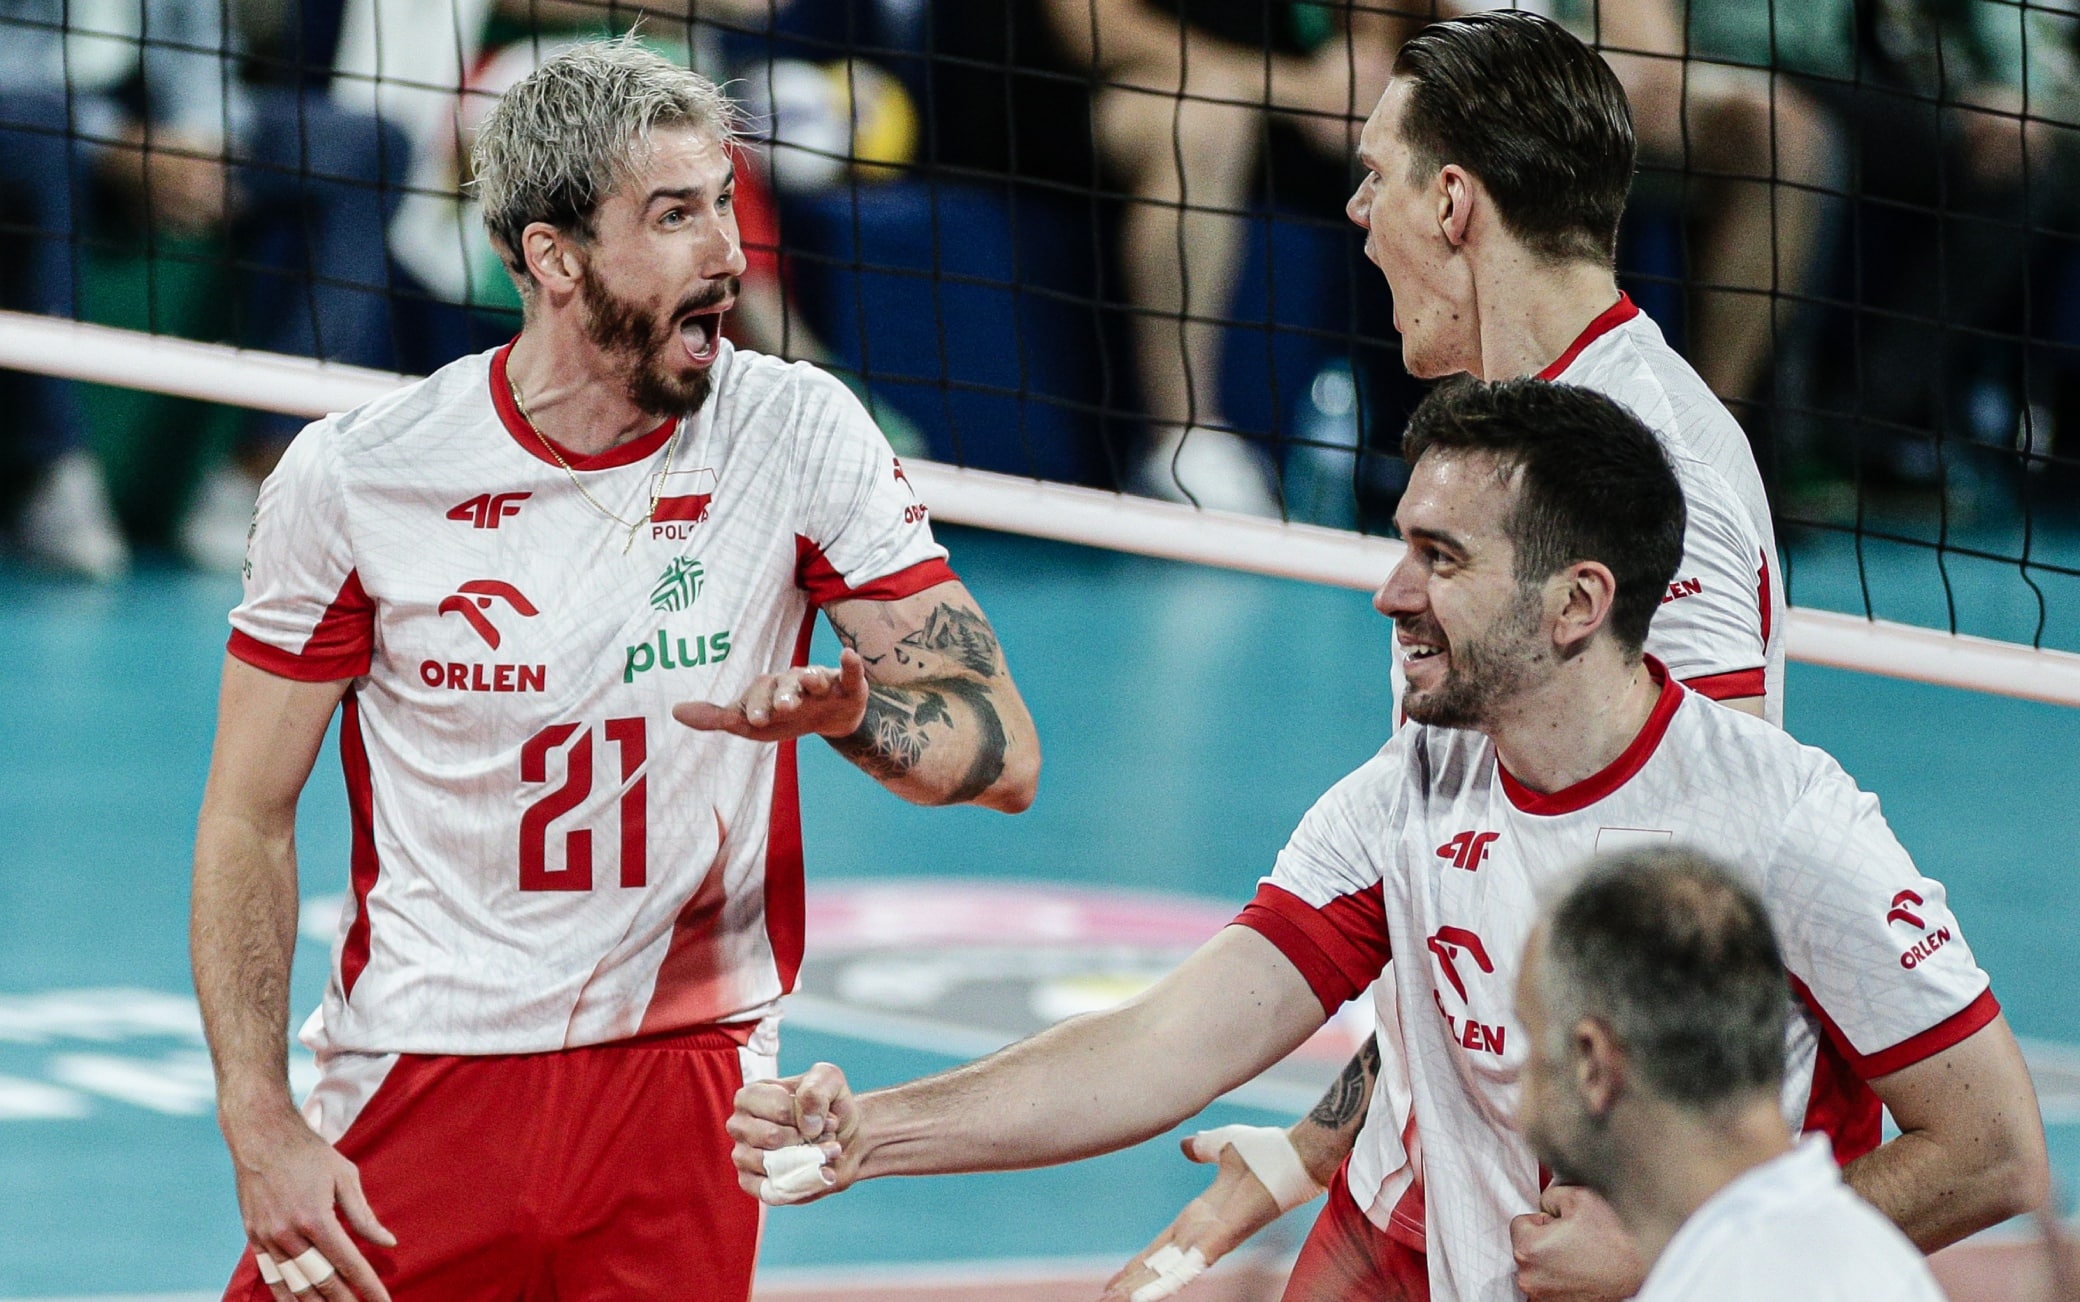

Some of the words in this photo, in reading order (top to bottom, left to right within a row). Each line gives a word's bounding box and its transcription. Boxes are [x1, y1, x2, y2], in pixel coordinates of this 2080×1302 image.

[652, 508, 709, 541] POLA
[420, 659, 546, 692] ORLEN
[623, 629, 732, 684] plus
[519, 716, 647, 891] 21
[1900, 926, 1951, 970] ORLEN
